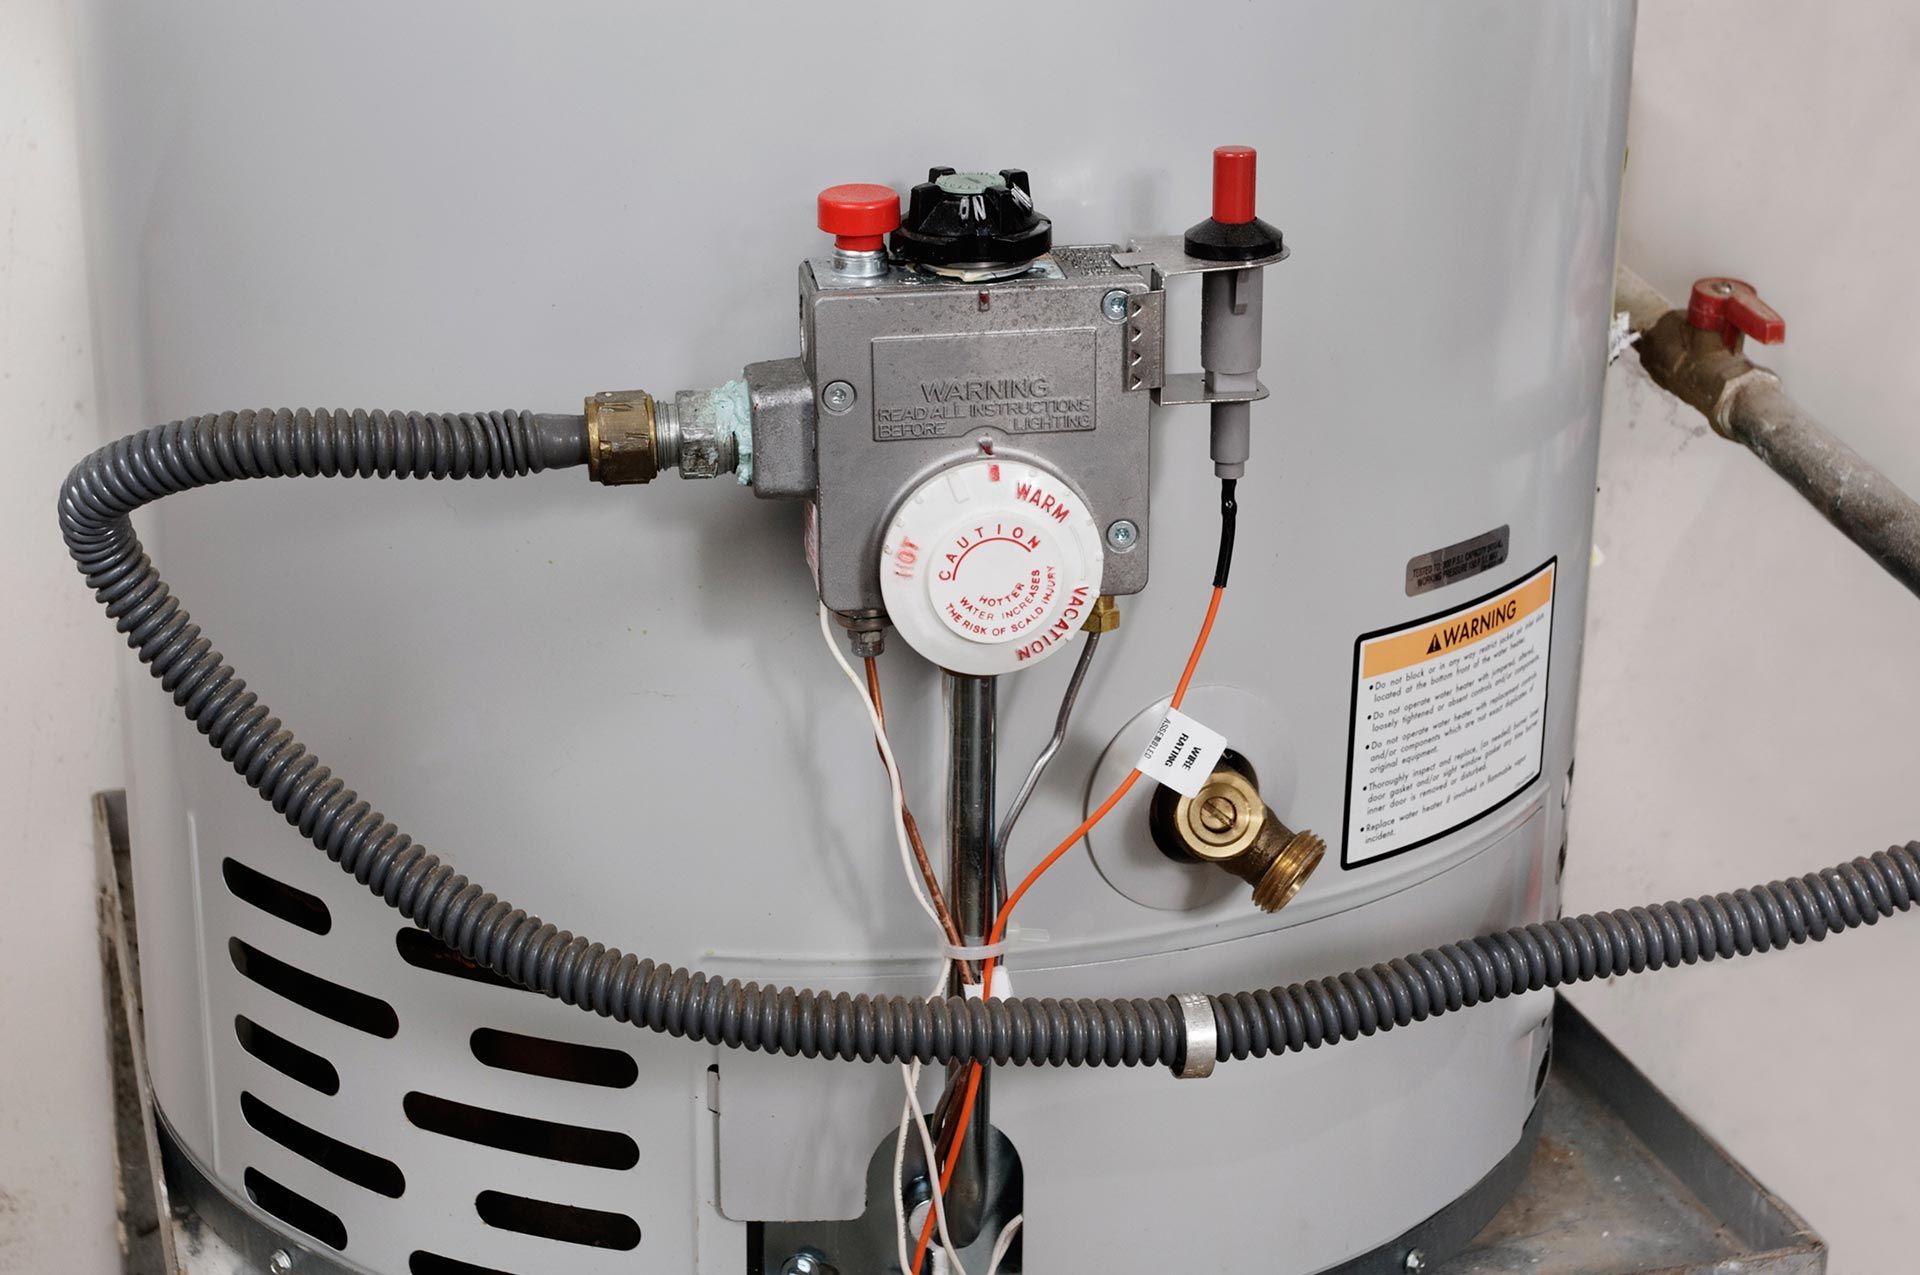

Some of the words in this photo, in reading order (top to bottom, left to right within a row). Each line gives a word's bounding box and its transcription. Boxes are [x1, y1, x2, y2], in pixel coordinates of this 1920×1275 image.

[959, 195, 987, 221] ON
[878, 406, 928, 422] READ
[928, 404, 966, 420] ALL
[969, 398, 1090, 418] INSTRUCTIONS
[920, 377, 1050, 404] WARNING
[879, 422, 947, 439] BEFORE
[1013, 415, 1091, 432] LIGHTING
[1015, 481, 1070, 524] WARM
[895, 536, 919, 579] HOT
[938, 523, 1041, 581] CAUTION
[945, 603, 963, 623] THE
[962, 620, 988, 636] RISK
[992, 626, 1006, 637] OF
[1011, 606, 1044, 632] SCALD
[1043, 565, 1057, 605] INJURY
[959, 596, 994, 621] WATER
[1001, 569, 1041, 620] INCREASES
[978, 582, 1025, 607] HOTTER
[1016, 585, 1089, 661] VACATION
[1443, 599, 1517, 648] WARNING
[1374, 687, 1402, 702] located
[1405, 685, 1413, 694] at
[1416, 681, 1427, 690] the
[1430, 672, 1453, 685] bottom
[1456, 664, 1471, 675] front
[1473, 658, 1480, 668] of
[1482, 656, 1491, 664] the
[1375, 681, 1386, 690] Do
[1390, 677, 1402, 686] not
[1405, 668, 1424, 682] block
[1428, 666, 1436, 674] or
[1439, 662, 1445, 670] in
[1449, 659, 1460, 667] any
[1464, 651, 1476, 660] way
[1372, 719, 1398, 732] loosely
[1402, 705, 1434, 724] tightened
[1437, 703, 1445, 711] or
[1448, 693, 1468, 707] absent
[1471, 681, 1492, 697] controls
[1373, 711, 1384, 720] Do
[1388, 706, 1400, 716] not
[1404, 697, 1430, 711] operate
[1435, 689, 1453, 700] water
[1456, 680, 1475, 692] heater
[1478, 672, 1489, 682] with
[1370, 749, 1397, 761] and/or
[1401, 734, 1441, 752] components
[1444, 724, 1461, 736] which
[1464, 720, 1474, 729] are
[1477, 713, 1487, 722] not
[1371, 741, 1383, 750] Do
[1386, 736, 1398, 745] not
[1402, 727, 1429, 741] operate
[1433, 719, 1451, 729] water
[1454, 709, 1473, 721] heater
[1476, 701, 1487, 711] with
[1164, 732, 1190, 768] RATING
[1182, 746, 1202, 771] WIRE
[1369, 758, 1399, 773] original
[1368, 793, 1386, 803] door
[1389, 783, 1413, 799] gasket
[1416, 774, 1440, 788] and/or
[1443, 765, 1458, 778] sight
[1461, 755, 1482, 769] window
[1369, 772, 1408, 791] Thoroughly
[1413, 763, 1436, 776] inspect
[1439, 755, 1452, 767] and
[1366, 819, 1395, 832] Replace
[1399, 810, 1419, 821] water
[1422, 800, 1443, 813] heater
[1453, 781, 1477, 800] involved
[1367, 804, 1386, 815] inner
[1389, 798, 1407, 808] door
[1419, 781, 1448, 798] removed
[1450, 778, 1457, 786] or
